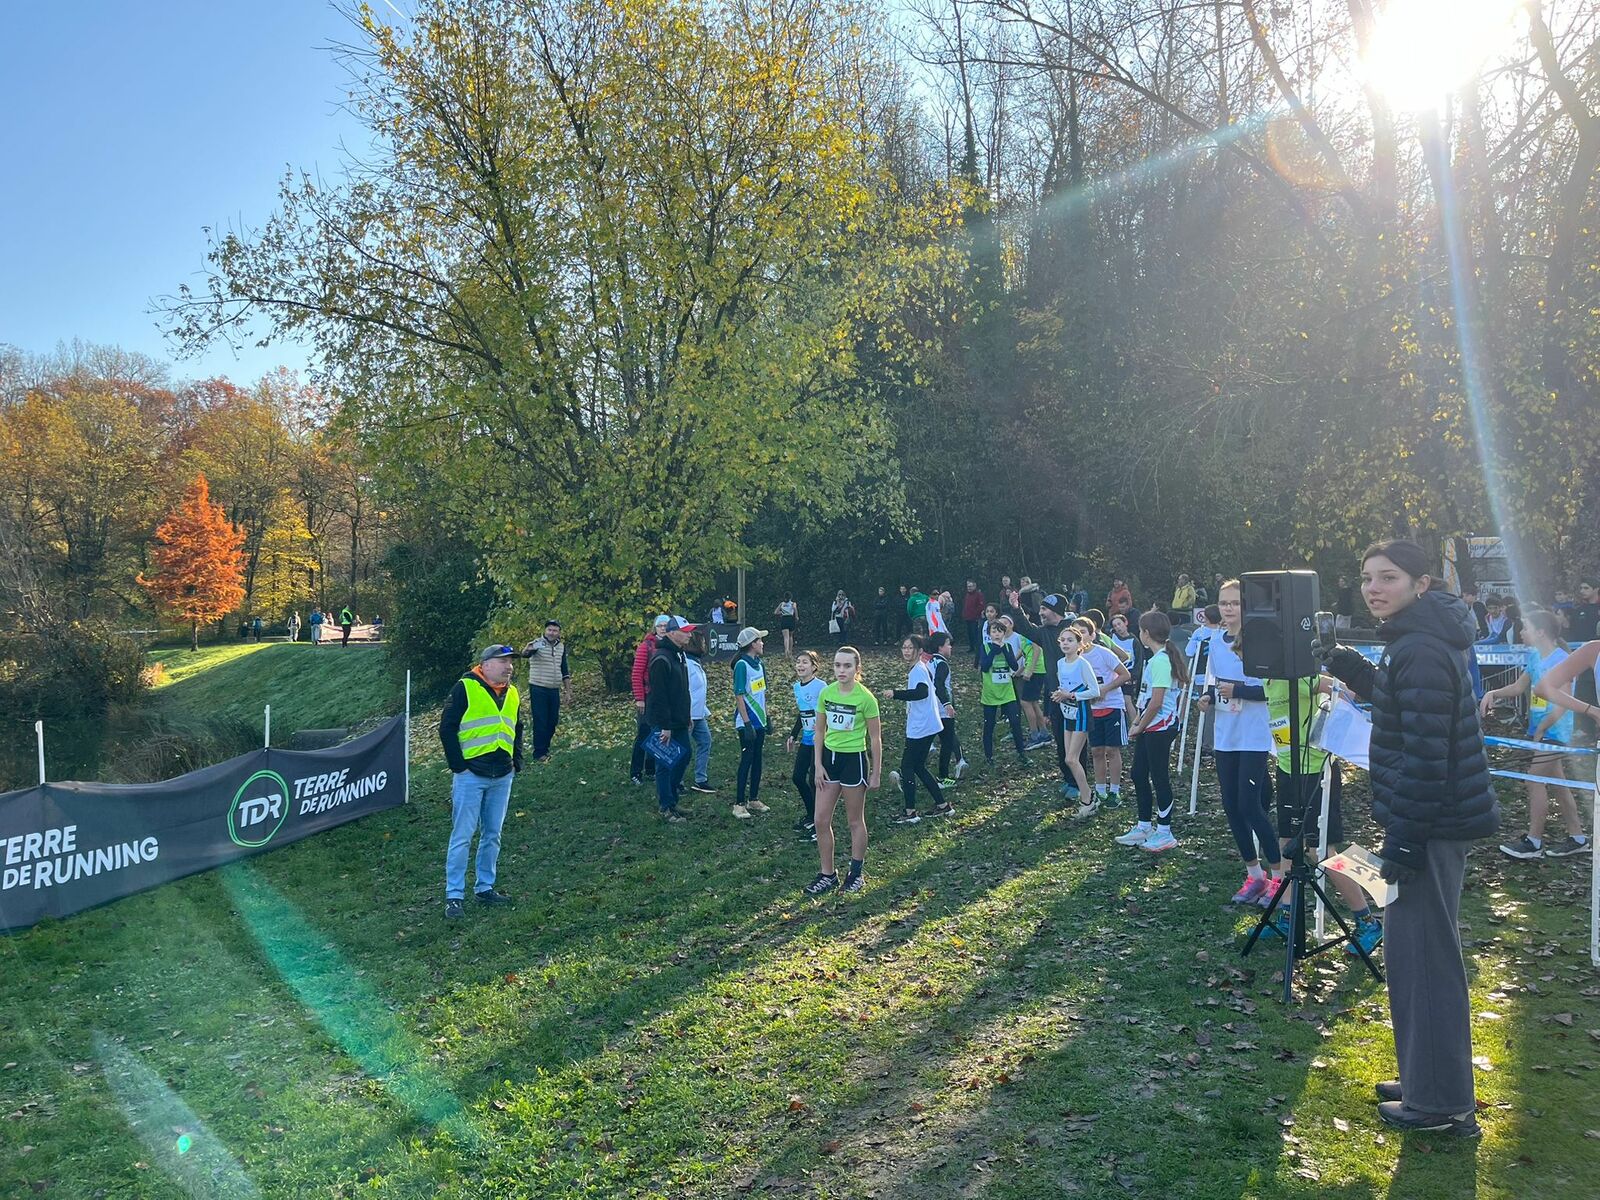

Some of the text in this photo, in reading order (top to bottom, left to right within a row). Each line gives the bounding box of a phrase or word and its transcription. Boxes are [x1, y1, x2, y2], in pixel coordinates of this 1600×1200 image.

[832, 713, 844, 724] 20
[1063, 705, 1071, 714] 21
[294, 767, 350, 800] TERRE
[299, 770, 388, 816] DE RUNNING
[238, 793, 282, 828] TDR
[2, 836, 159, 890] DE RUNNING
